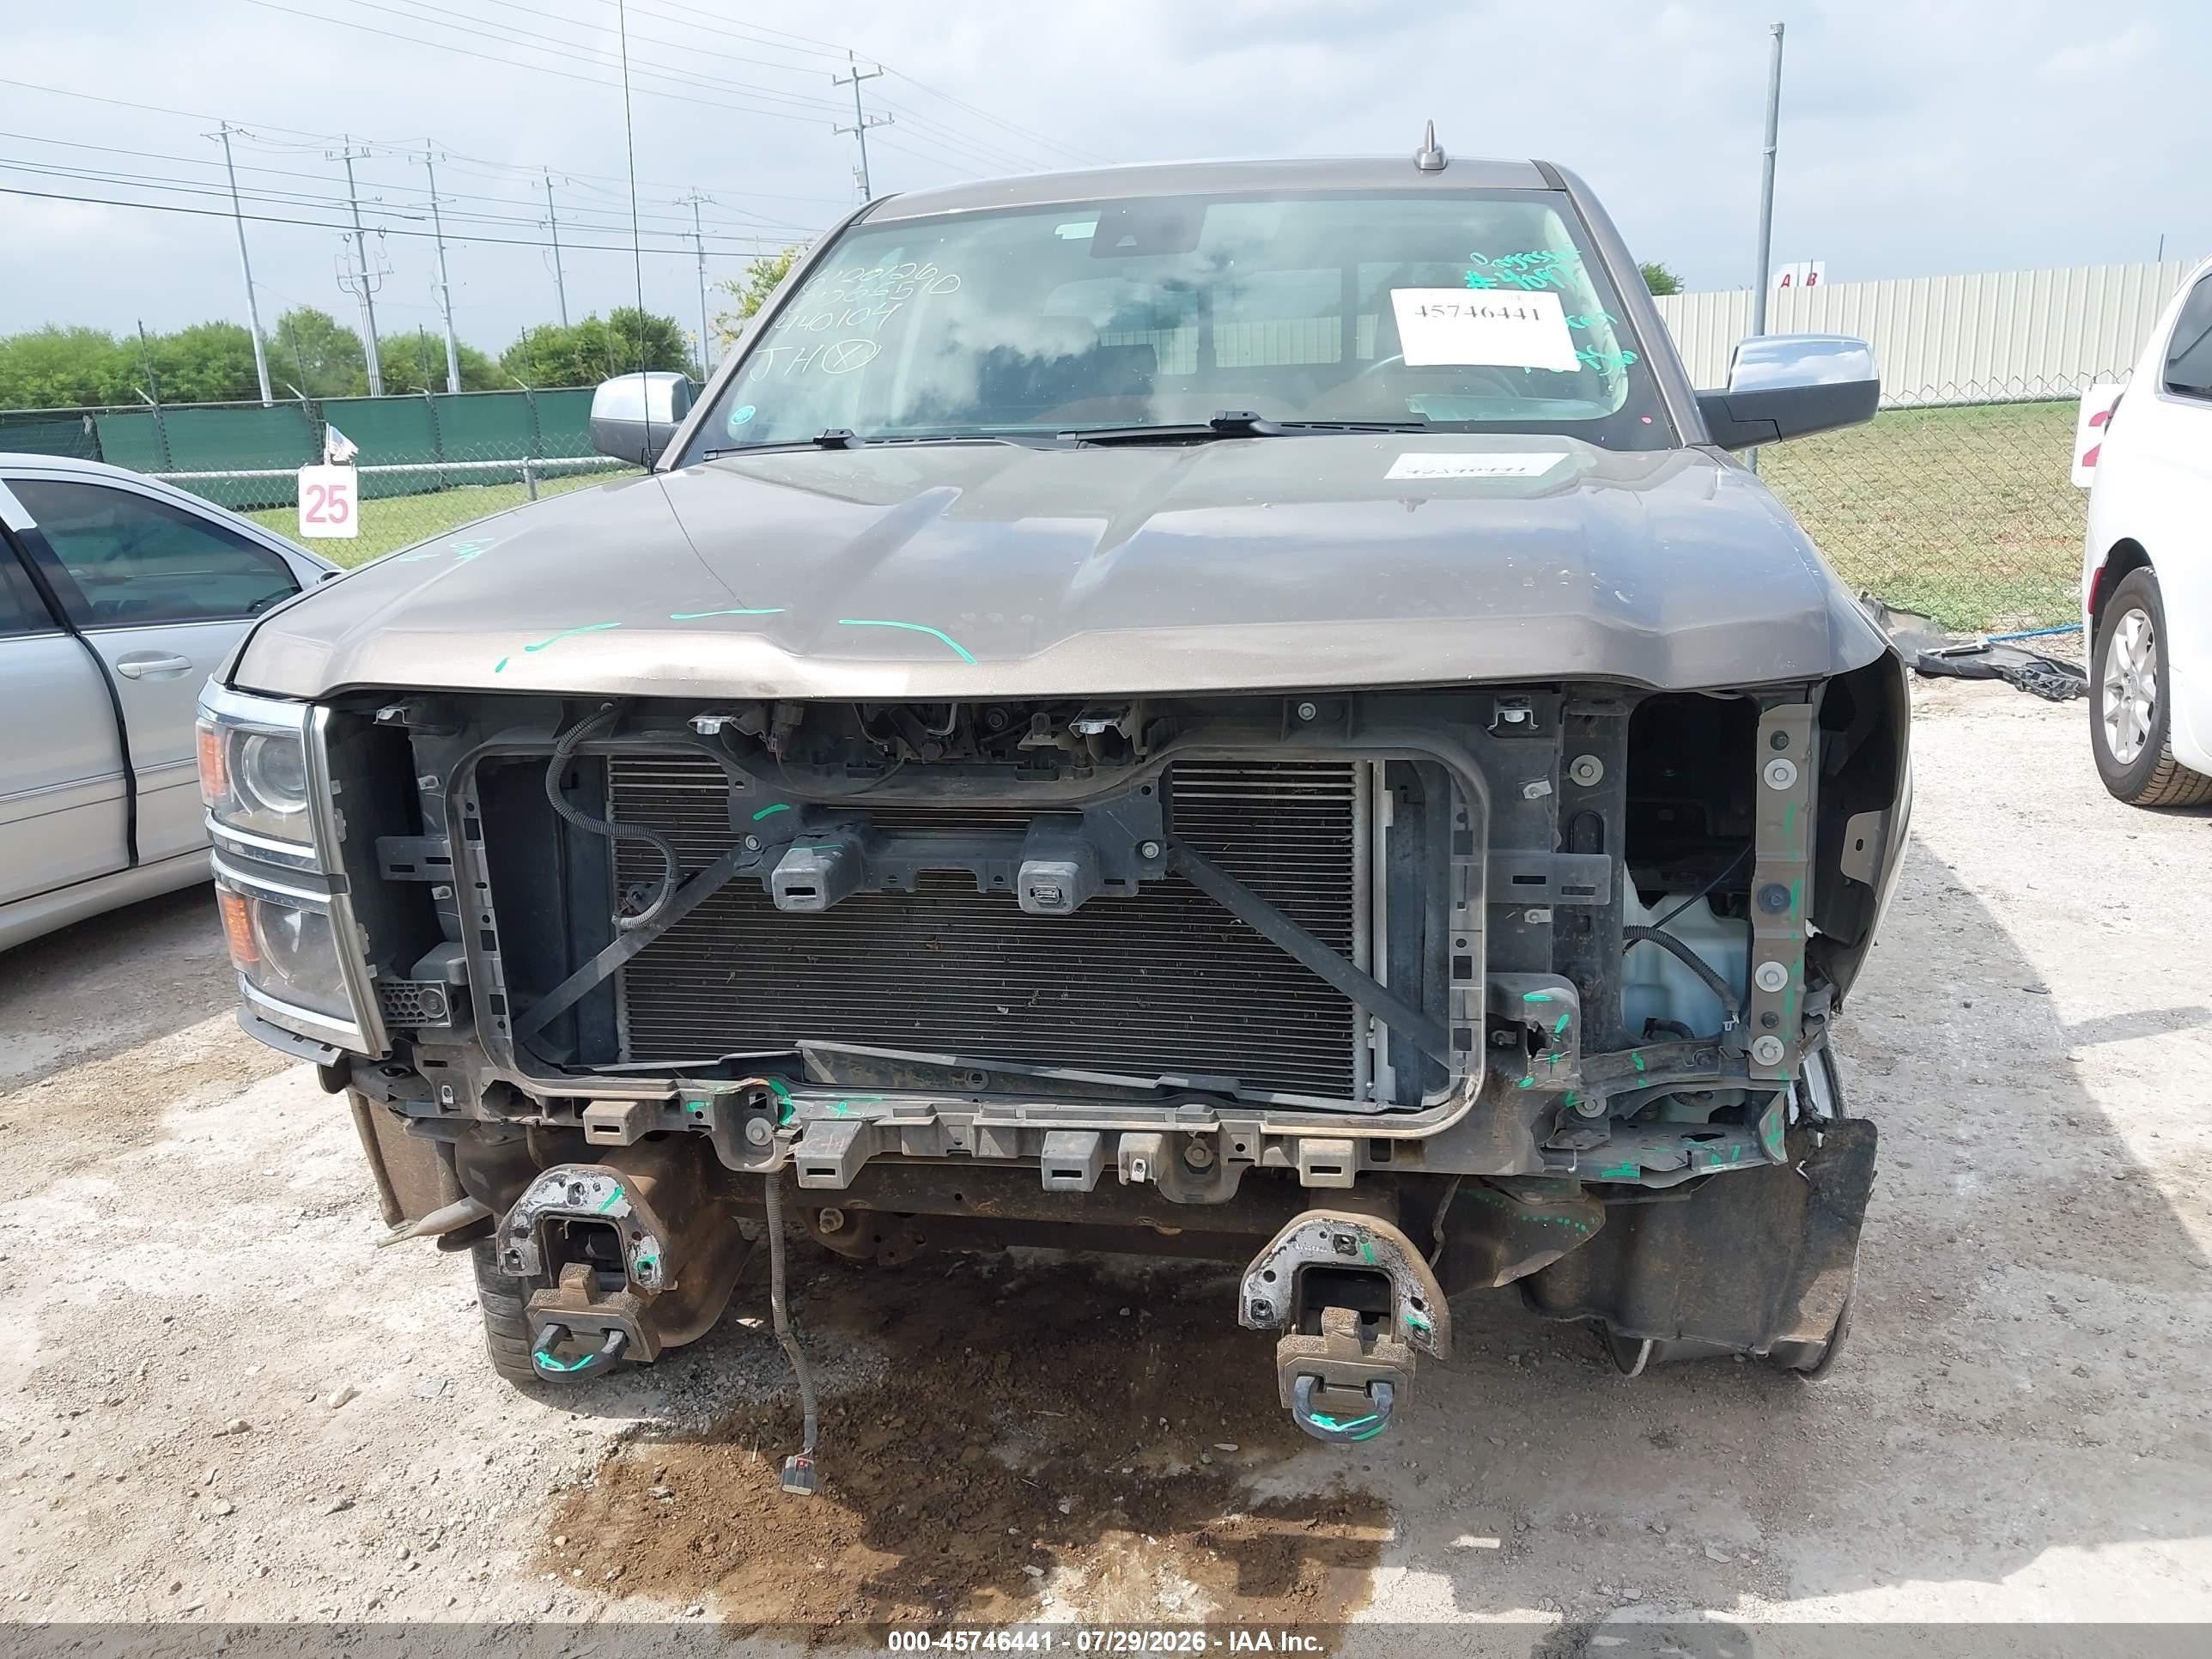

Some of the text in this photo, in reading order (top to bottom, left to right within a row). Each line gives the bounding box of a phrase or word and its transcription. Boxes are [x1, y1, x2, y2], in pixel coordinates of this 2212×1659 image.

[1781, 272, 1818, 288] A B
[1415, 305, 1540, 321] 45746441
[306, 484, 349, 524] 25
